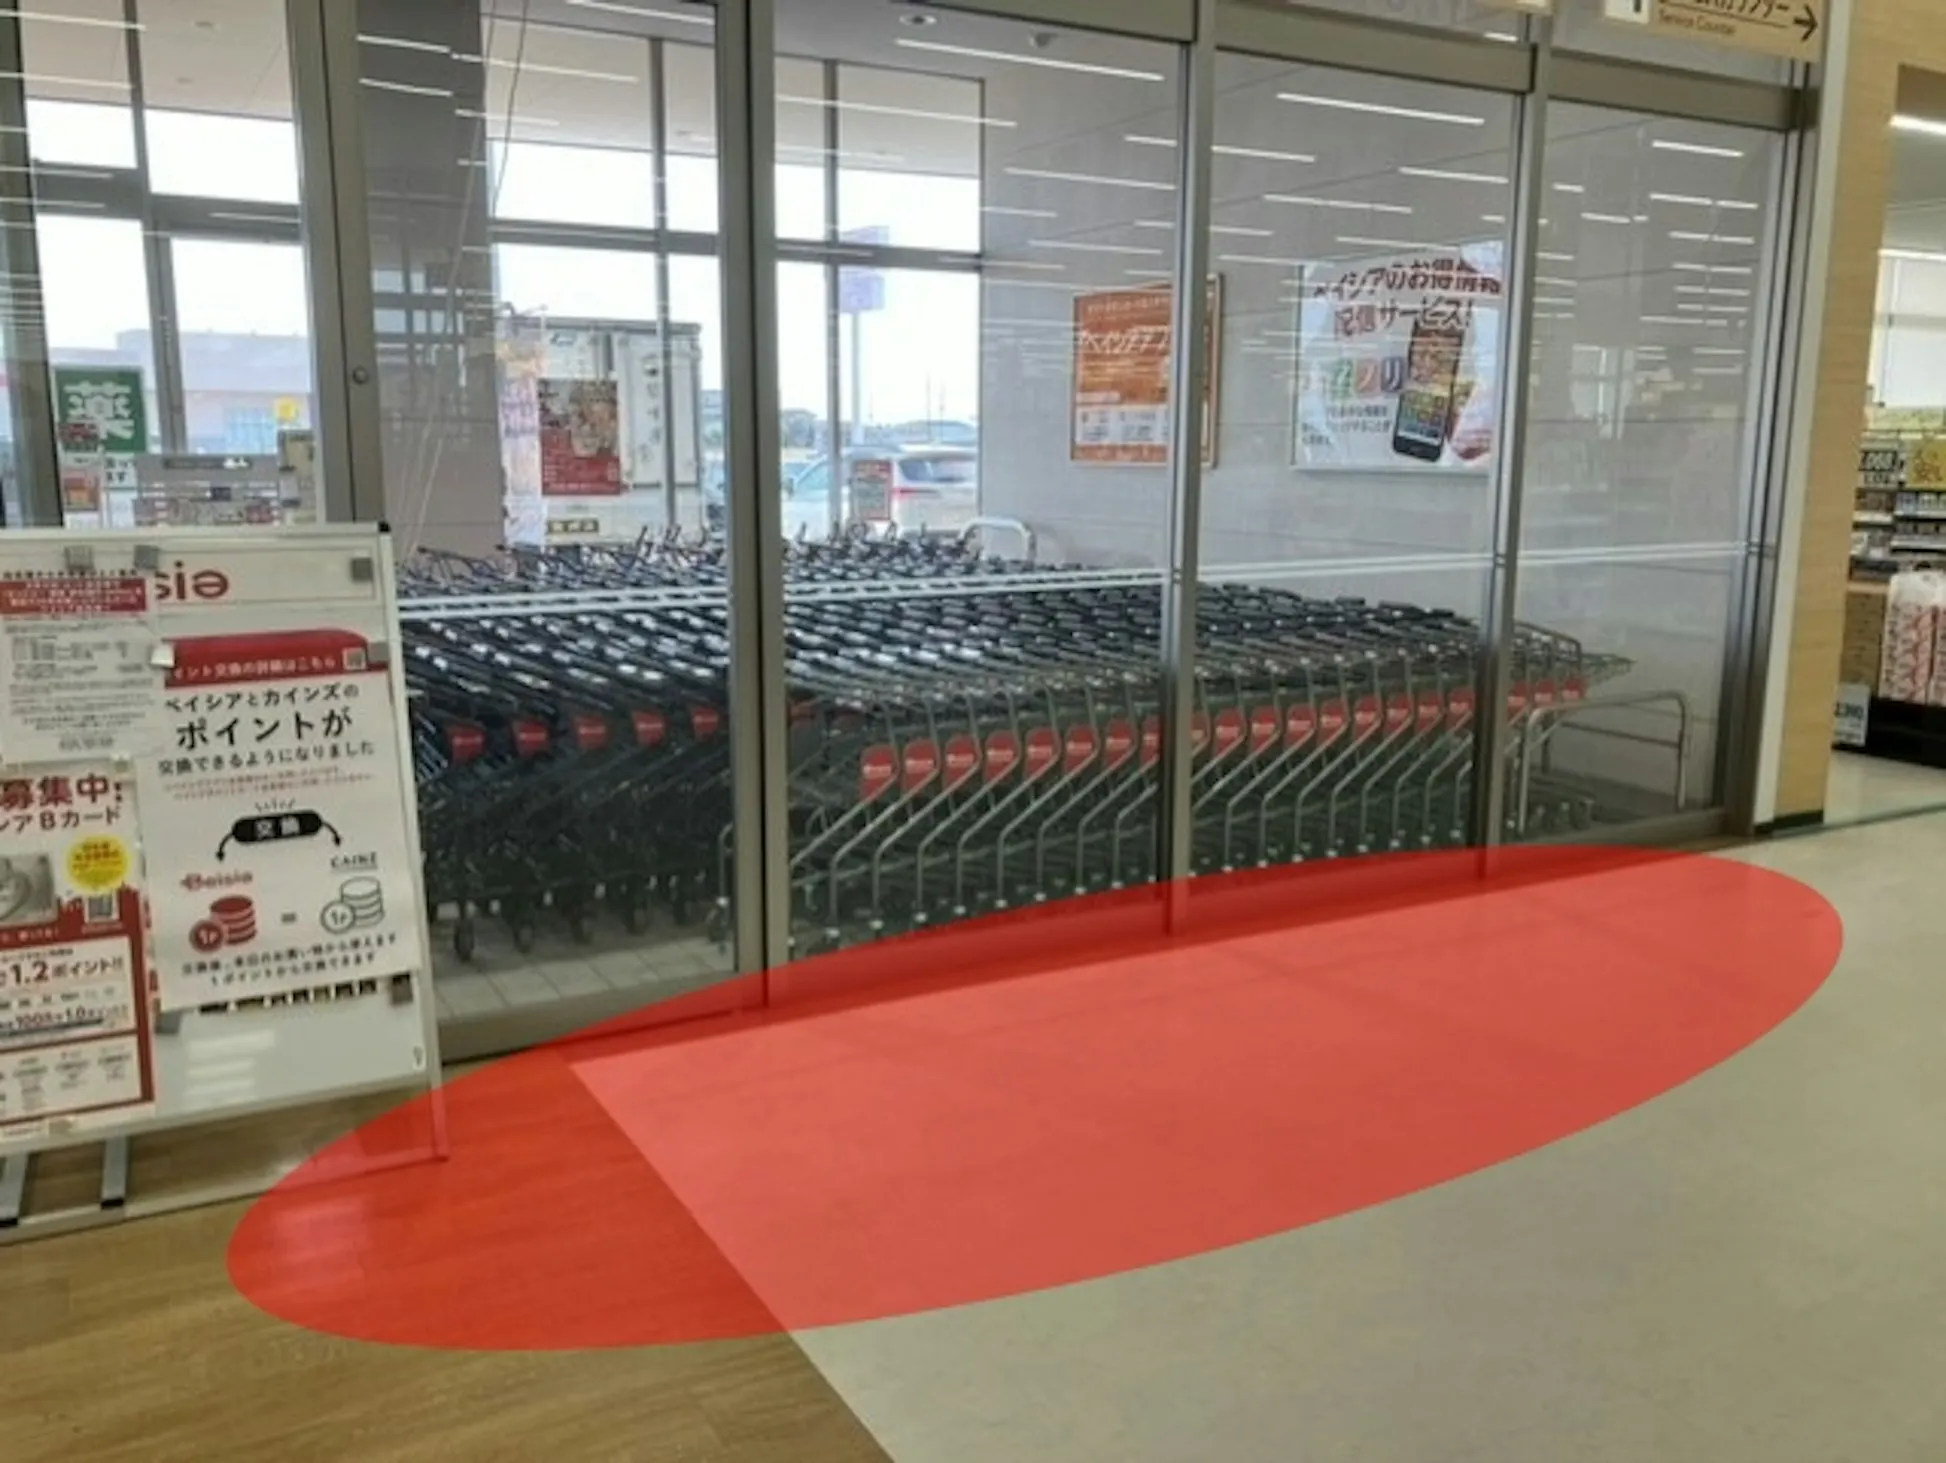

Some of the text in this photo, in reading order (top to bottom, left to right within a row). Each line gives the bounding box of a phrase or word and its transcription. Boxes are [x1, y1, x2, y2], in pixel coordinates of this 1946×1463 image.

[176, 706, 353, 750] ポイントが
[158, 741, 374, 776] 交換できるようになりました
